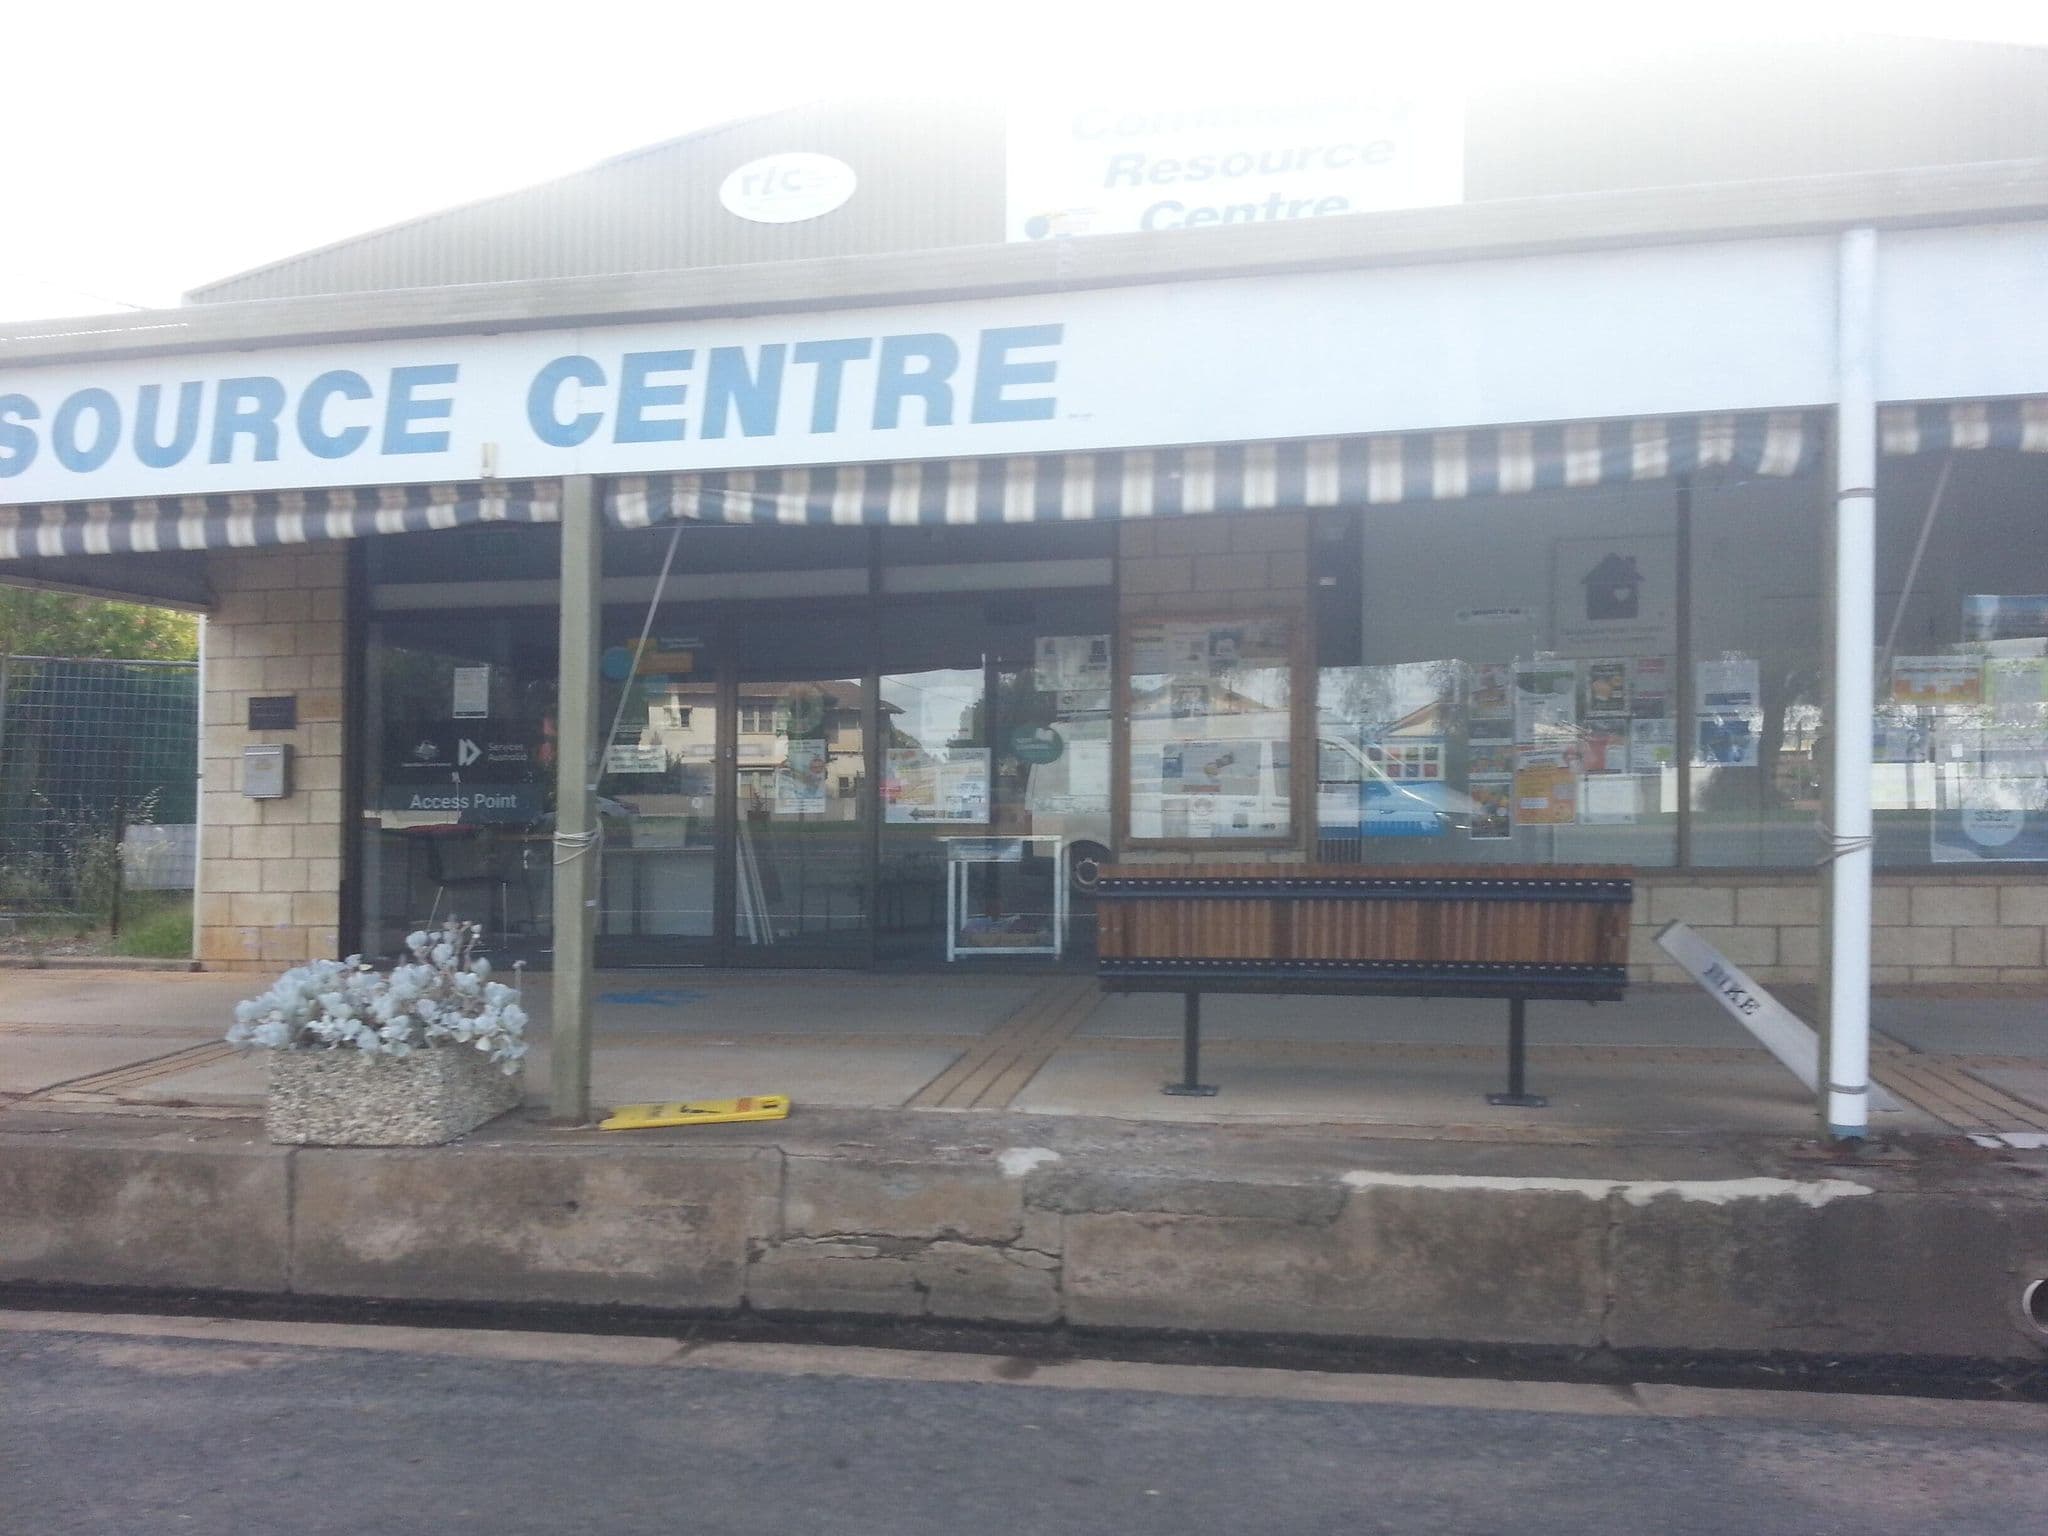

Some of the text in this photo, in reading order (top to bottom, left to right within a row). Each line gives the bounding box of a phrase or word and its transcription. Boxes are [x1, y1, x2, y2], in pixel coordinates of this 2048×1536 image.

[1103, 136, 1396, 189] Resource
[1139, 192, 1351, 231] Centre
[526, 323, 1065, 447] CENTRE
[409, 793, 518, 809] Access Point
